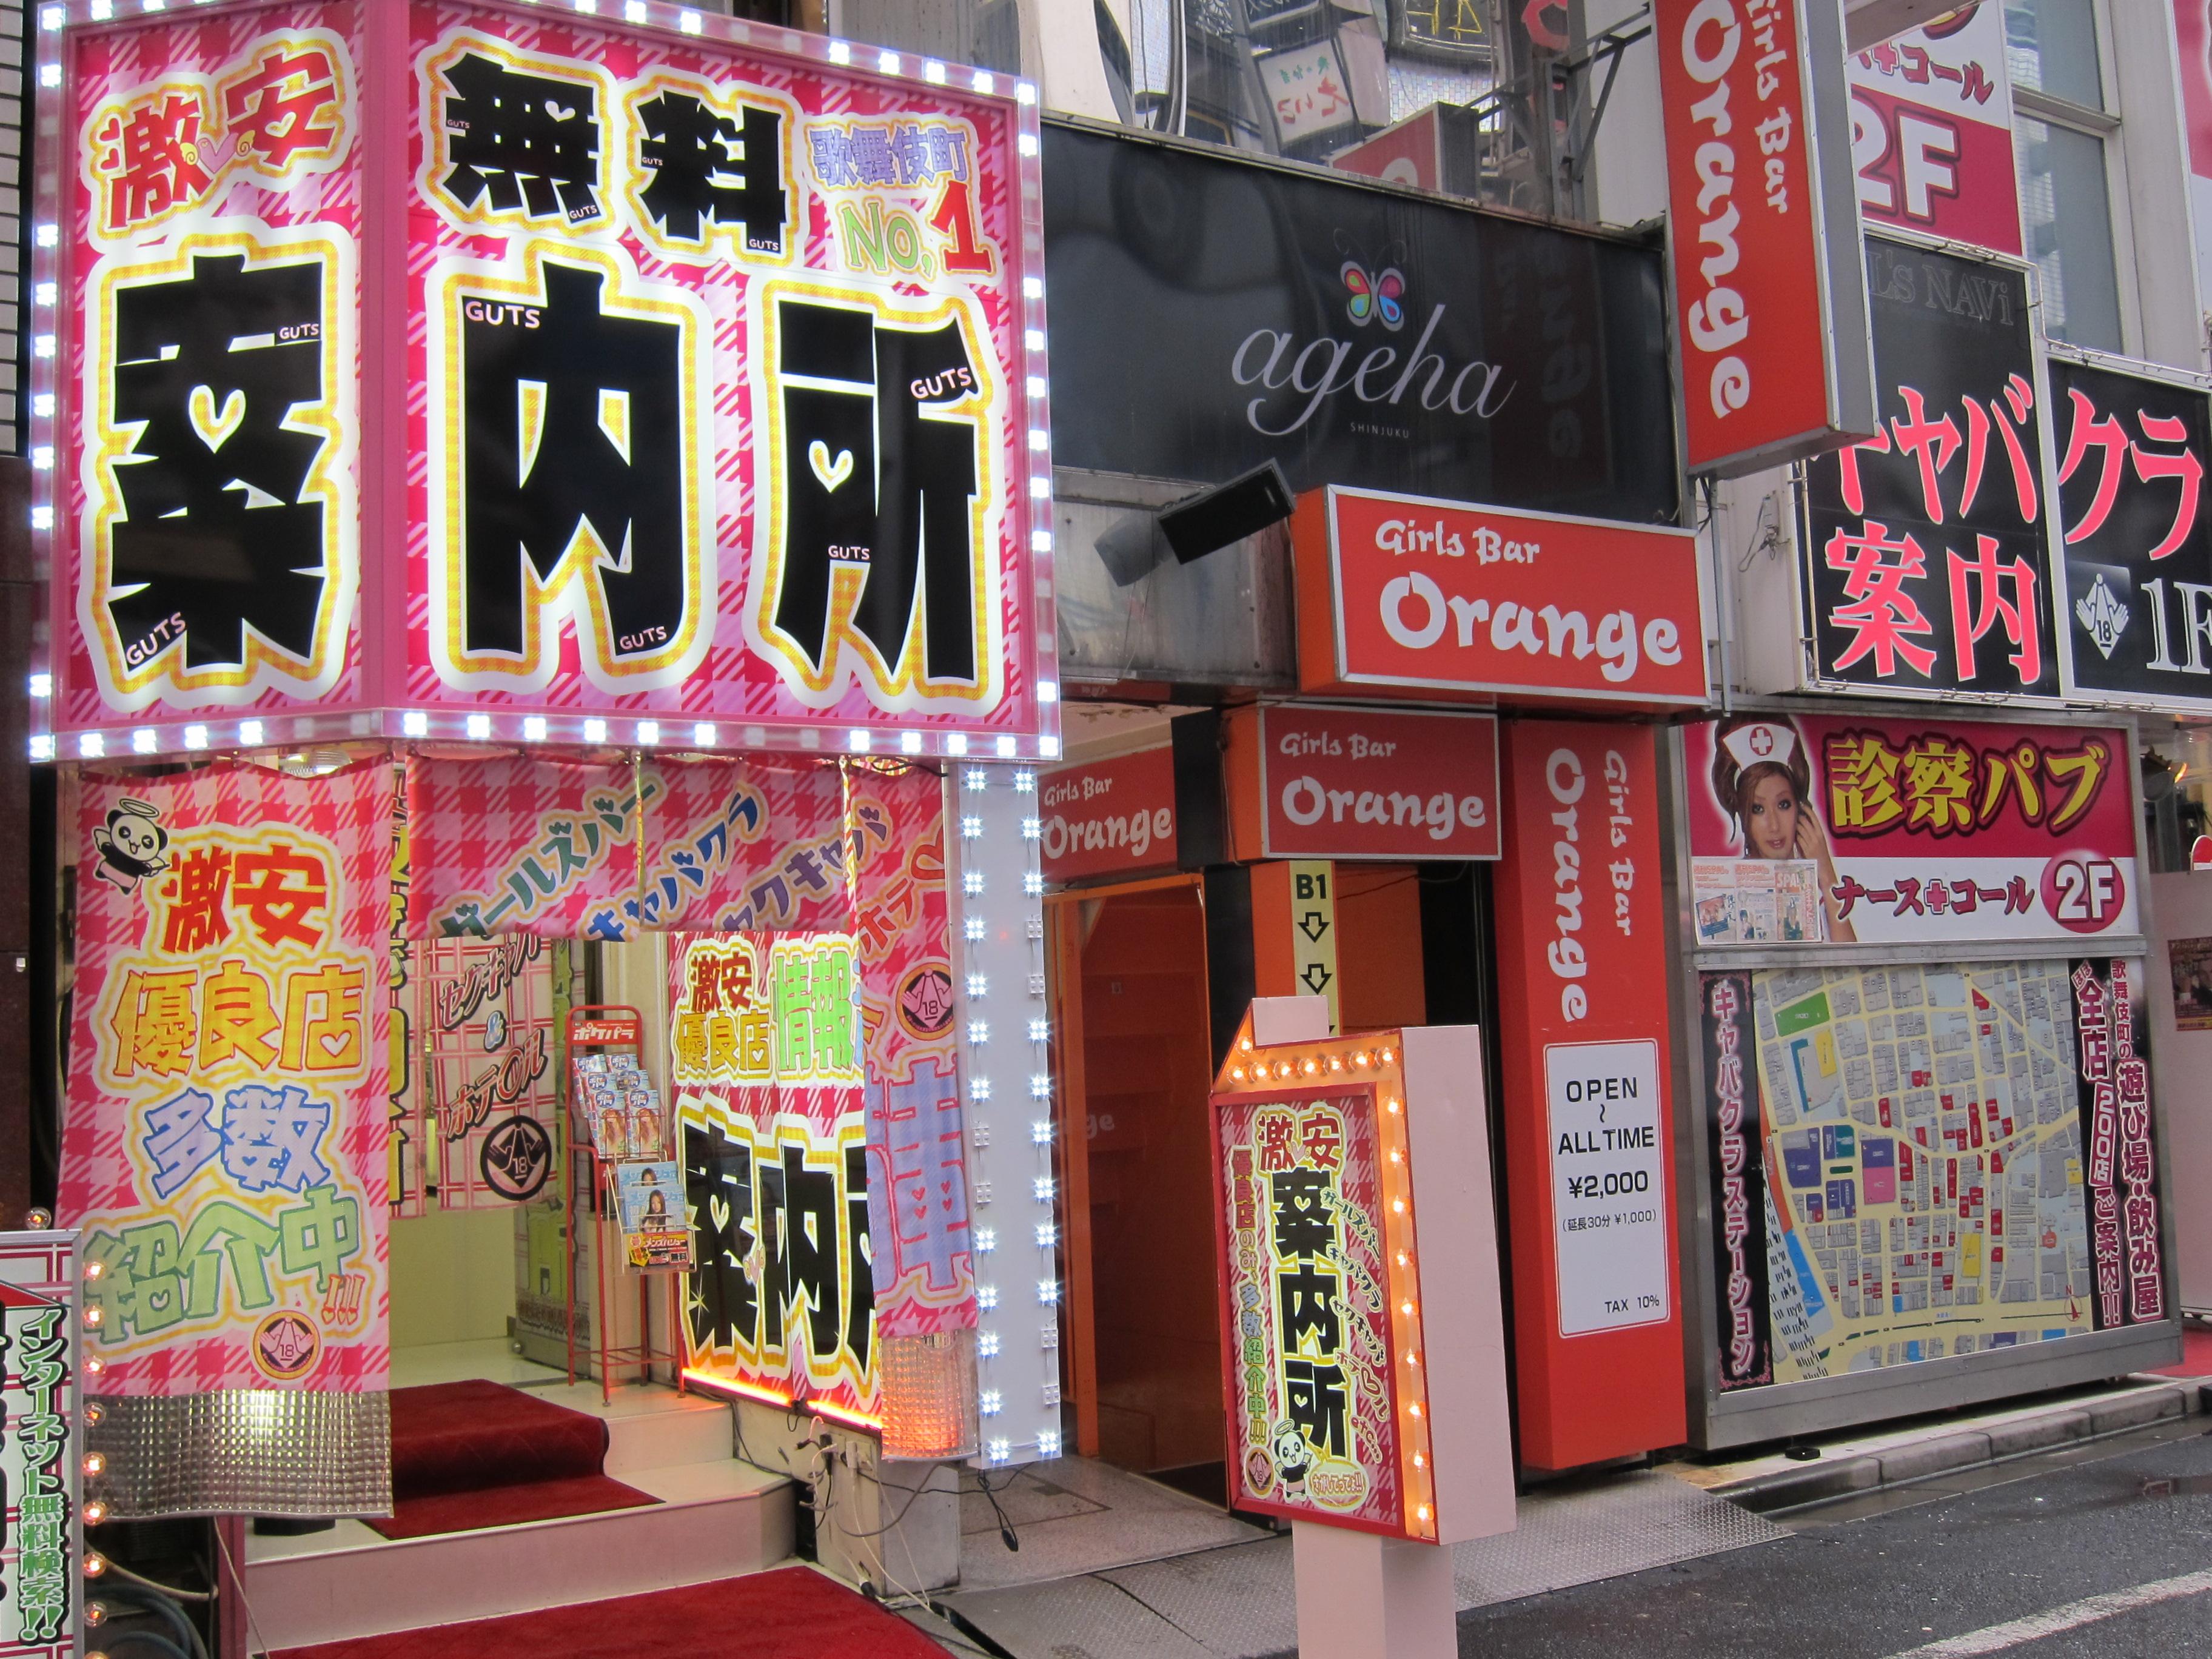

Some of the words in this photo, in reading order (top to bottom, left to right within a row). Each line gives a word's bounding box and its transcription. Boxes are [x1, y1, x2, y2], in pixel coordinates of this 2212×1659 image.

[1746, 0, 1788, 101] irls
[99, 51, 338, 229] 激安
[442, 52, 786, 255] 無料
[446, 119, 471, 130] GUTS
[641, 156, 663, 167] GUTS
[809, 126, 968, 186] 歌舞伎町
[1755, 107, 1792, 214] Bar
[1851, 98, 1957, 219] 2F
[568, 204, 598, 221] GUTS
[1681, 0, 1750, 419] Orange
[748, 238, 780, 252] GUTS
[279, 323, 320, 340] GUTS
[465, 301, 541, 329] GUTS
[910, 367, 973, 401] GUTS
[1232, 304, 1517, 435] ageha
[1350, 421, 1410, 439] SHINJUKU
[828, 545, 871, 561] GUTS
[1375, 520, 1466, 558] Girls
[1472, 526, 1541, 566] Bar
[1379, 571, 1683, 682] Orange
[1825, 519, 2041, 684] 案内
[2096, 620, 2113, 642] 18
[2140, 577, 2212, 675] 1F
[126, 611, 187, 666] GUTS
[619, 625, 668, 651] GUTS
[1279, 731, 1342, 759] Girls
[1347, 733, 1396, 760] Bar
[1043, 782, 1080, 808] Girls
[1081, 775, 1113, 802] Bar
[1281, 775, 1486, 840] Orange
[1603, 750, 1633, 848] Girls
[1829, 736, 2108, 831] 診察パブ
[440, 784, 656, 938] ガールズバー
[1041, 807, 1173, 860] Orange
[587, 792, 758, 942] キャバクラ
[1296, 873, 1327, 900] B1
[1546, 748, 1588, 1022] Orange
[1608, 857, 1635, 937] Bar
[2056, 859, 2114, 921] 2F
[161, 844, 328, 953] 激安
[691, 951, 753, 1013] 激安
[776, 951, 856, 1071] 情報
[922, 1000, 938, 1017] 18
[110, 959, 366, 1078] 優良店
[486, 1011, 504, 1050] &
[573, 1022, 635, 1041] ポケパラ
[675, 1008, 771, 1072] 優良店
[1566, 1077, 1638, 1102] OPEN
[142, 1084, 331, 1199] 多数
[513, 1156, 528, 1173] 18
[1258, 1112, 1341, 1171] 激安
[1558, 1131, 1601, 1155] ALL
[1605, 1126, 1655, 1151] TIME
[1568, 1170, 1649, 1199] ¥2,000
[1711, 985, 1754, 1376] キャバクラステーション
[1323, 1190, 1381, 1259] ガールズバー
[1562, 1213, 1610, 1232] (延長30分
[1614, 1209, 1657, 1226] ¥1,000)
[1329, 1247, 1381, 1308] キャバクラ
[1604, 1298, 1629, 1314] TAX
[1637, 1295, 1660, 1310] 10%
[1271, 1167, 1347, 1458] 案内所
[280, 1344, 295, 1358] 18
[19, 1308, 65, 1642] インターネット無料検索!!
